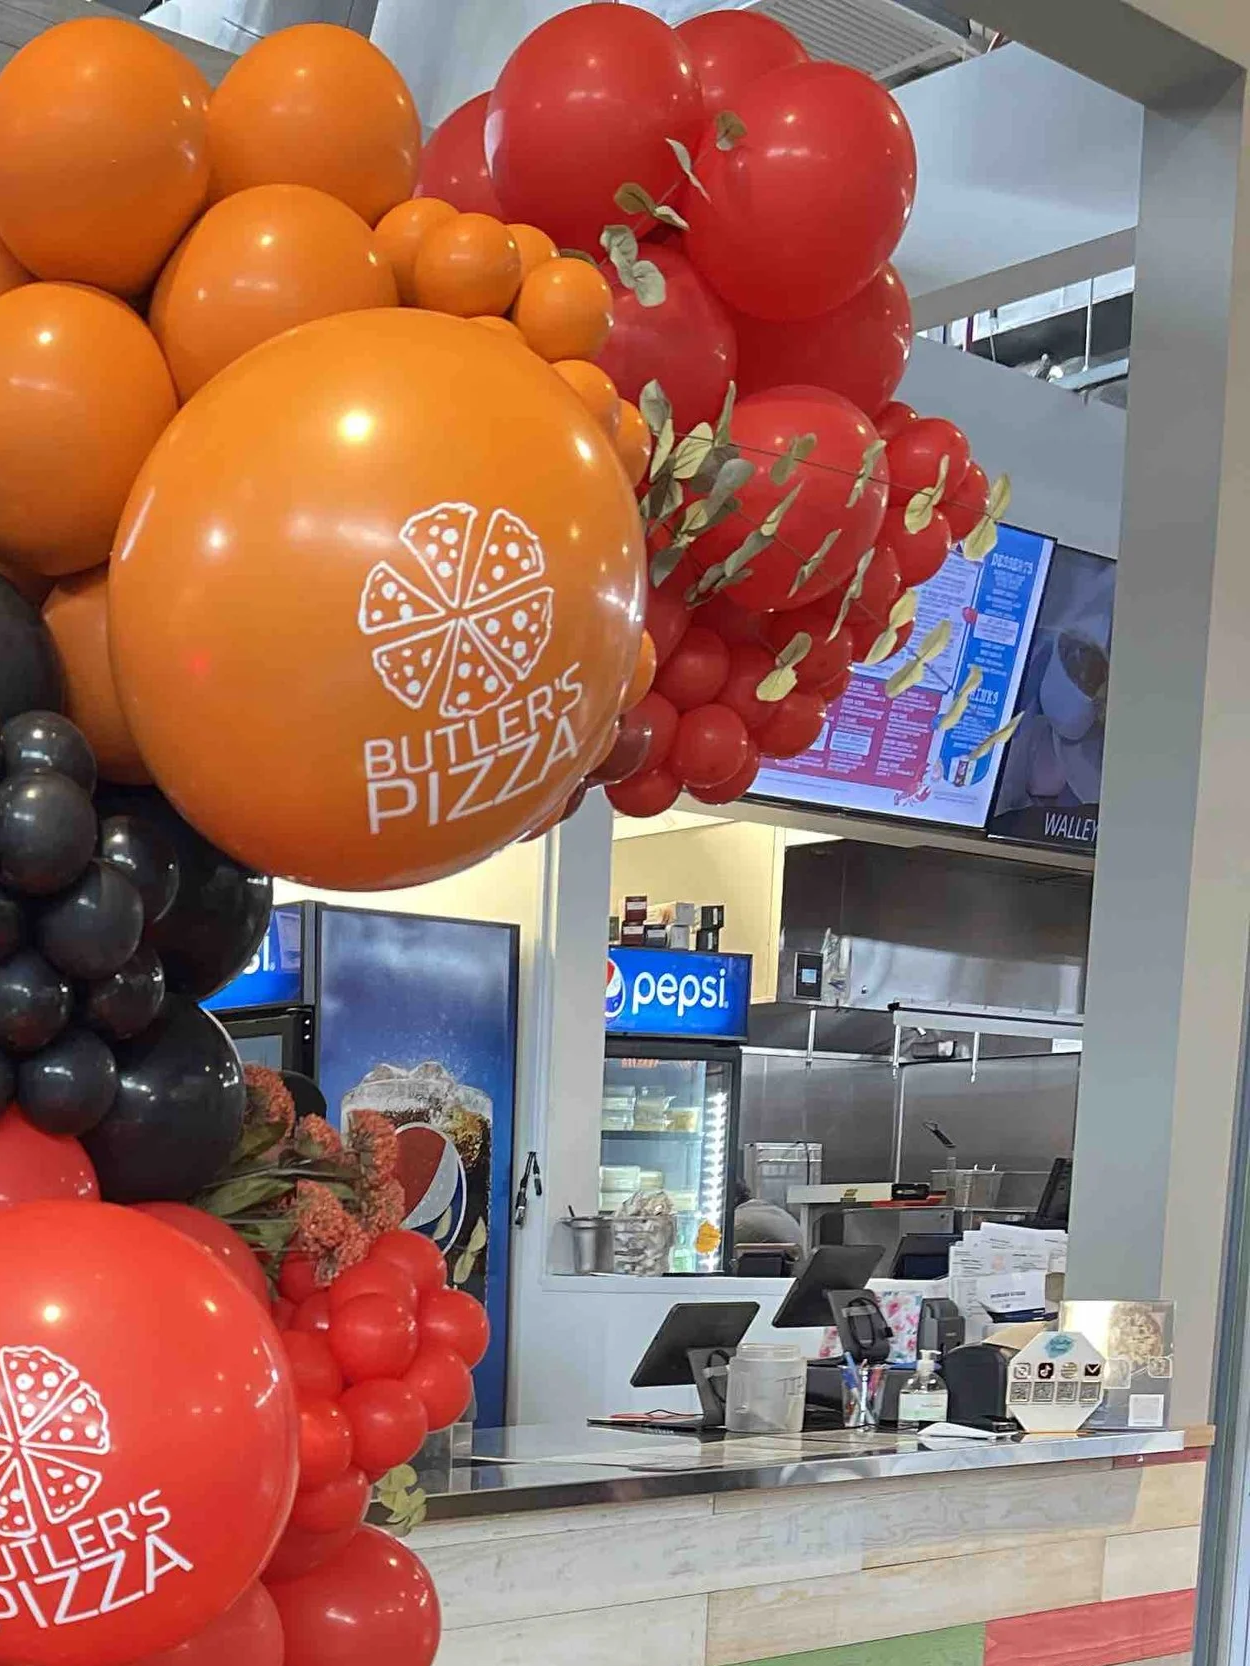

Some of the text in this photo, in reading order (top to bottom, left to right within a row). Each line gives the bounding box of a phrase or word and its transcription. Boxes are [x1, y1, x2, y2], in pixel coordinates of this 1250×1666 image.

[363, 661, 583, 780] BUTLER'S
[366, 715, 579, 835] PIZZA
[631, 968, 727, 1017] pepsi
